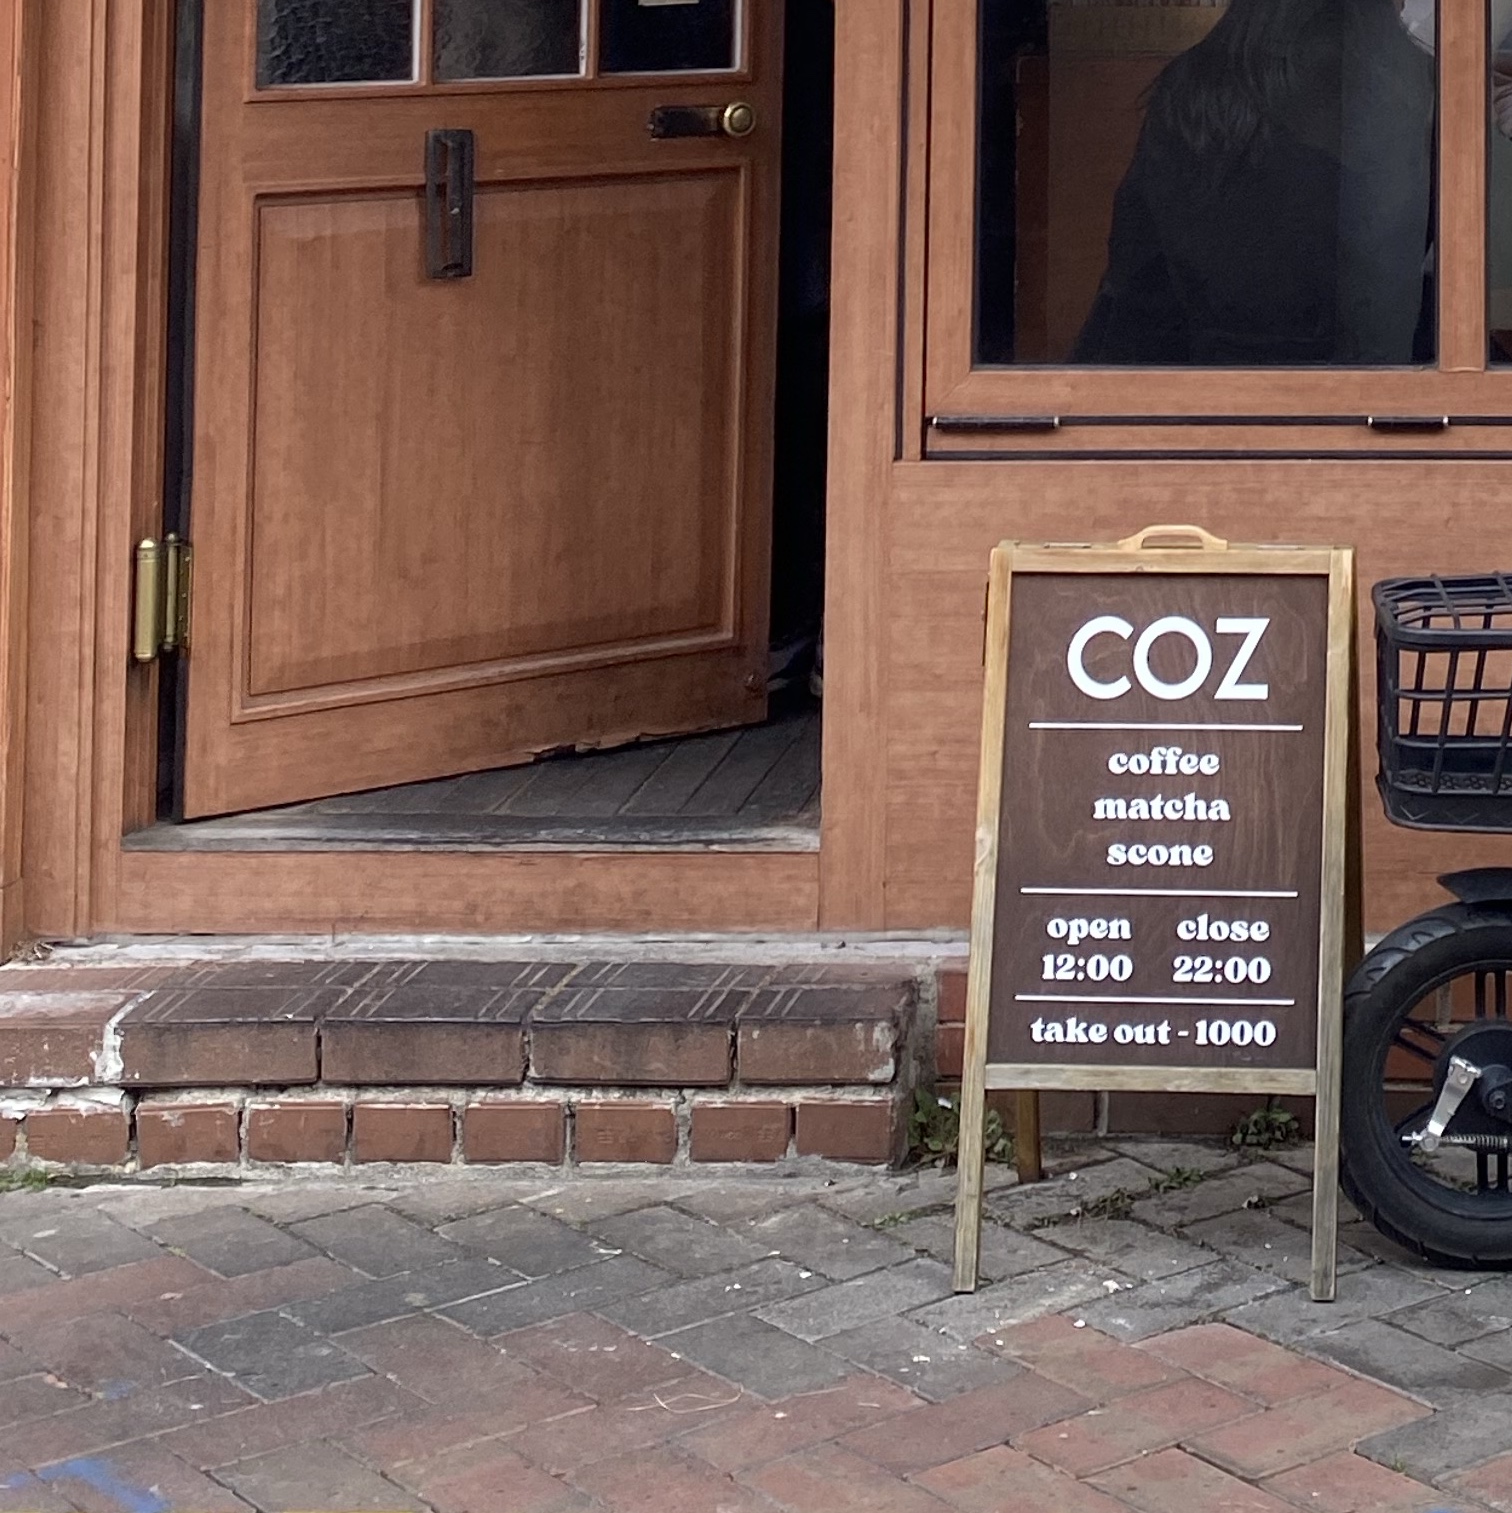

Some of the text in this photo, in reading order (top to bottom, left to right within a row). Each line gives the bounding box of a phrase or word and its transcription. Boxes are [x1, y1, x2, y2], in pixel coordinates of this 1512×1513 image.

[1066, 615, 1271, 700] COZ
[1108, 746, 1220, 776] coffee
[1092, 792, 1231, 821] matcha
[1106, 842, 1213, 867] scone
[1046, 914, 1270, 945] open close
[1041, 954, 1271, 984] 12:00 22:00
[1030, 1017, 1108, 1045] take
[1113, 1019, 1171, 1045] out
